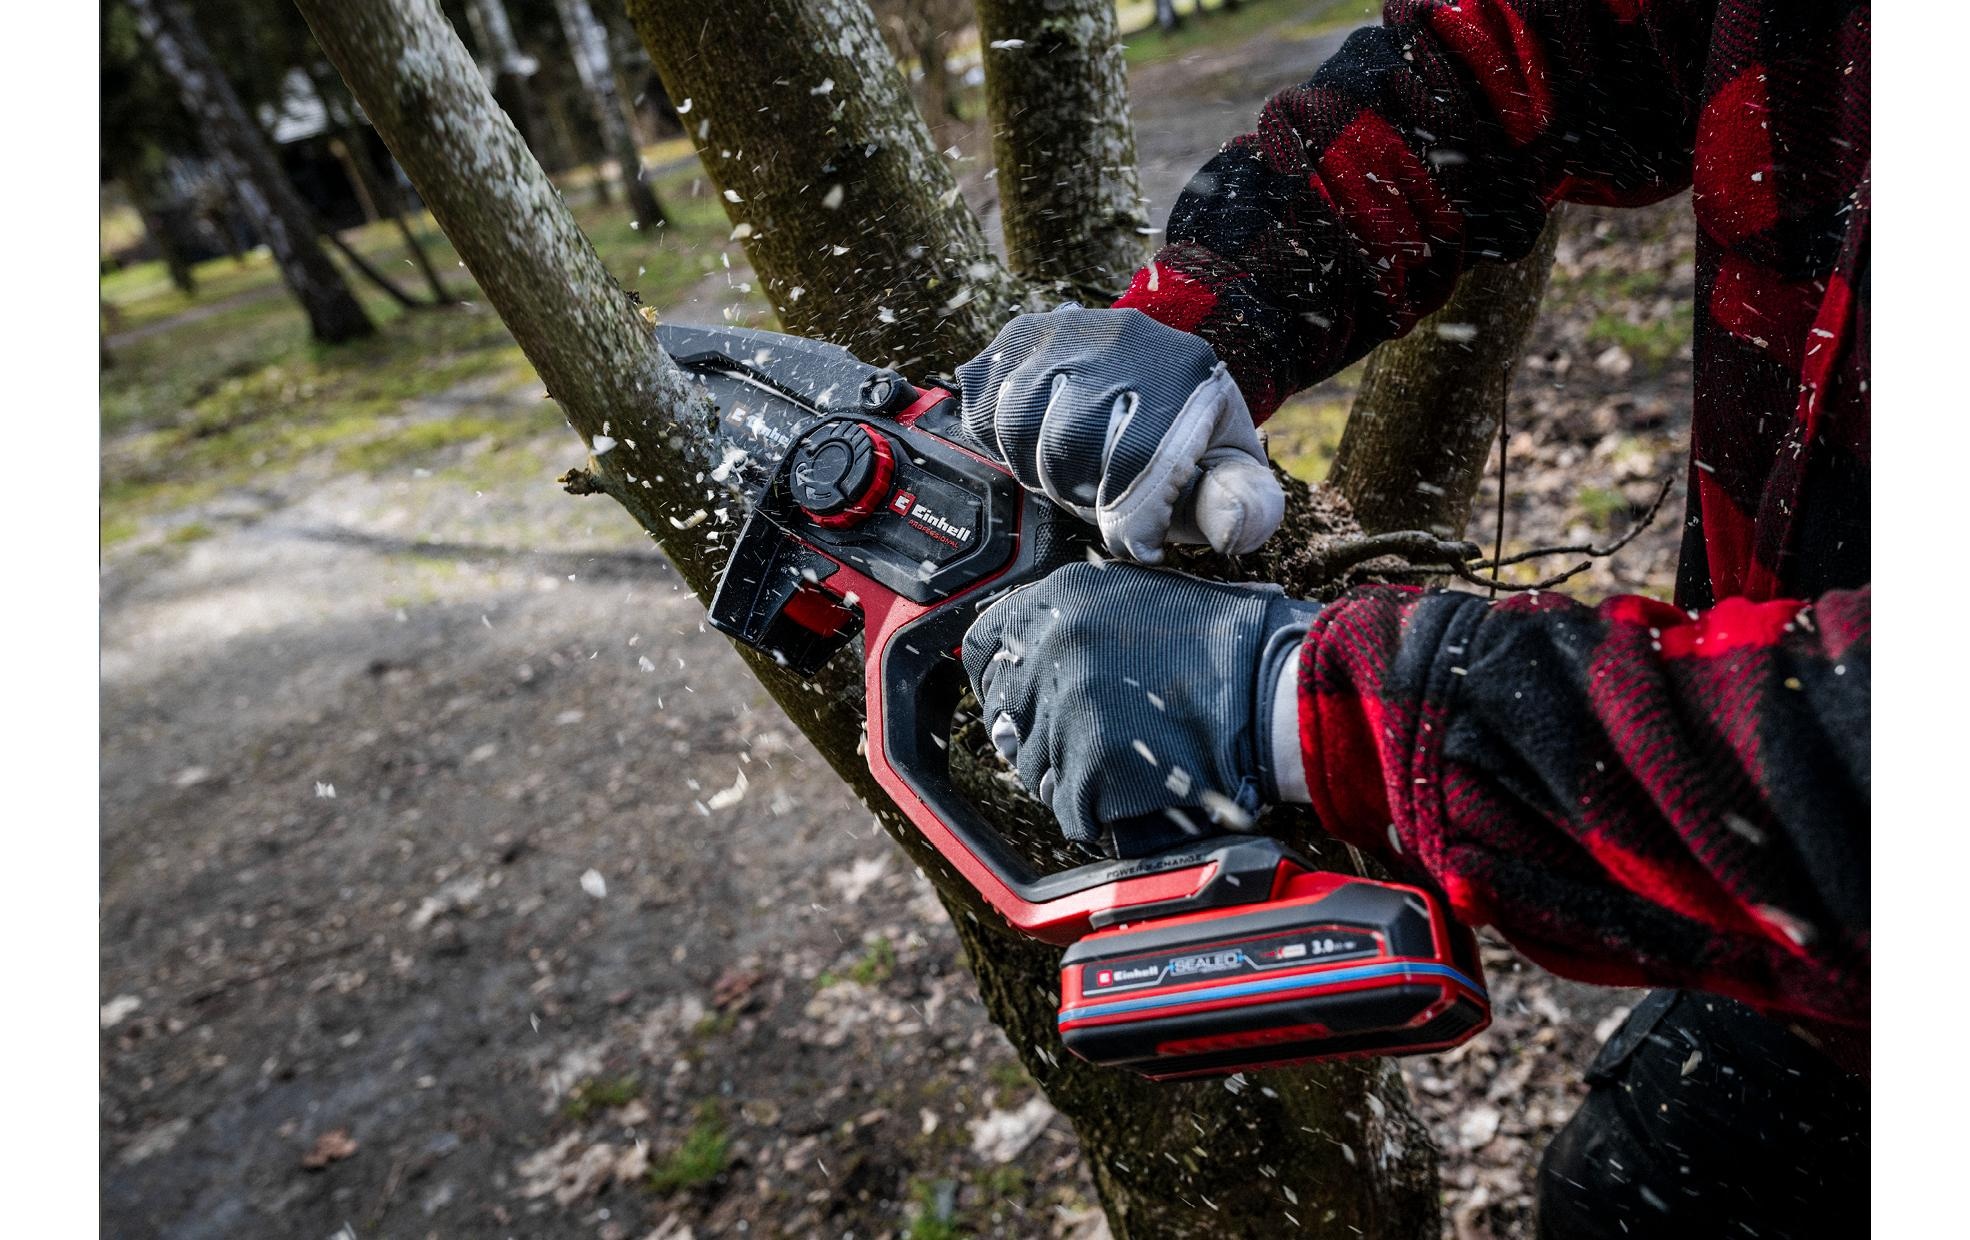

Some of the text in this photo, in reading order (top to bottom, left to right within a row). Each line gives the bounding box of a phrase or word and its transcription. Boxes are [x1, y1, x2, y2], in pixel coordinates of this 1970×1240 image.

[908, 519, 959, 549] PROFESSIONAL
[911, 503, 972, 542] Einhell
[1312, 938, 1334, 955] 3.0
[1113, 965, 1159, 981] Einhell
